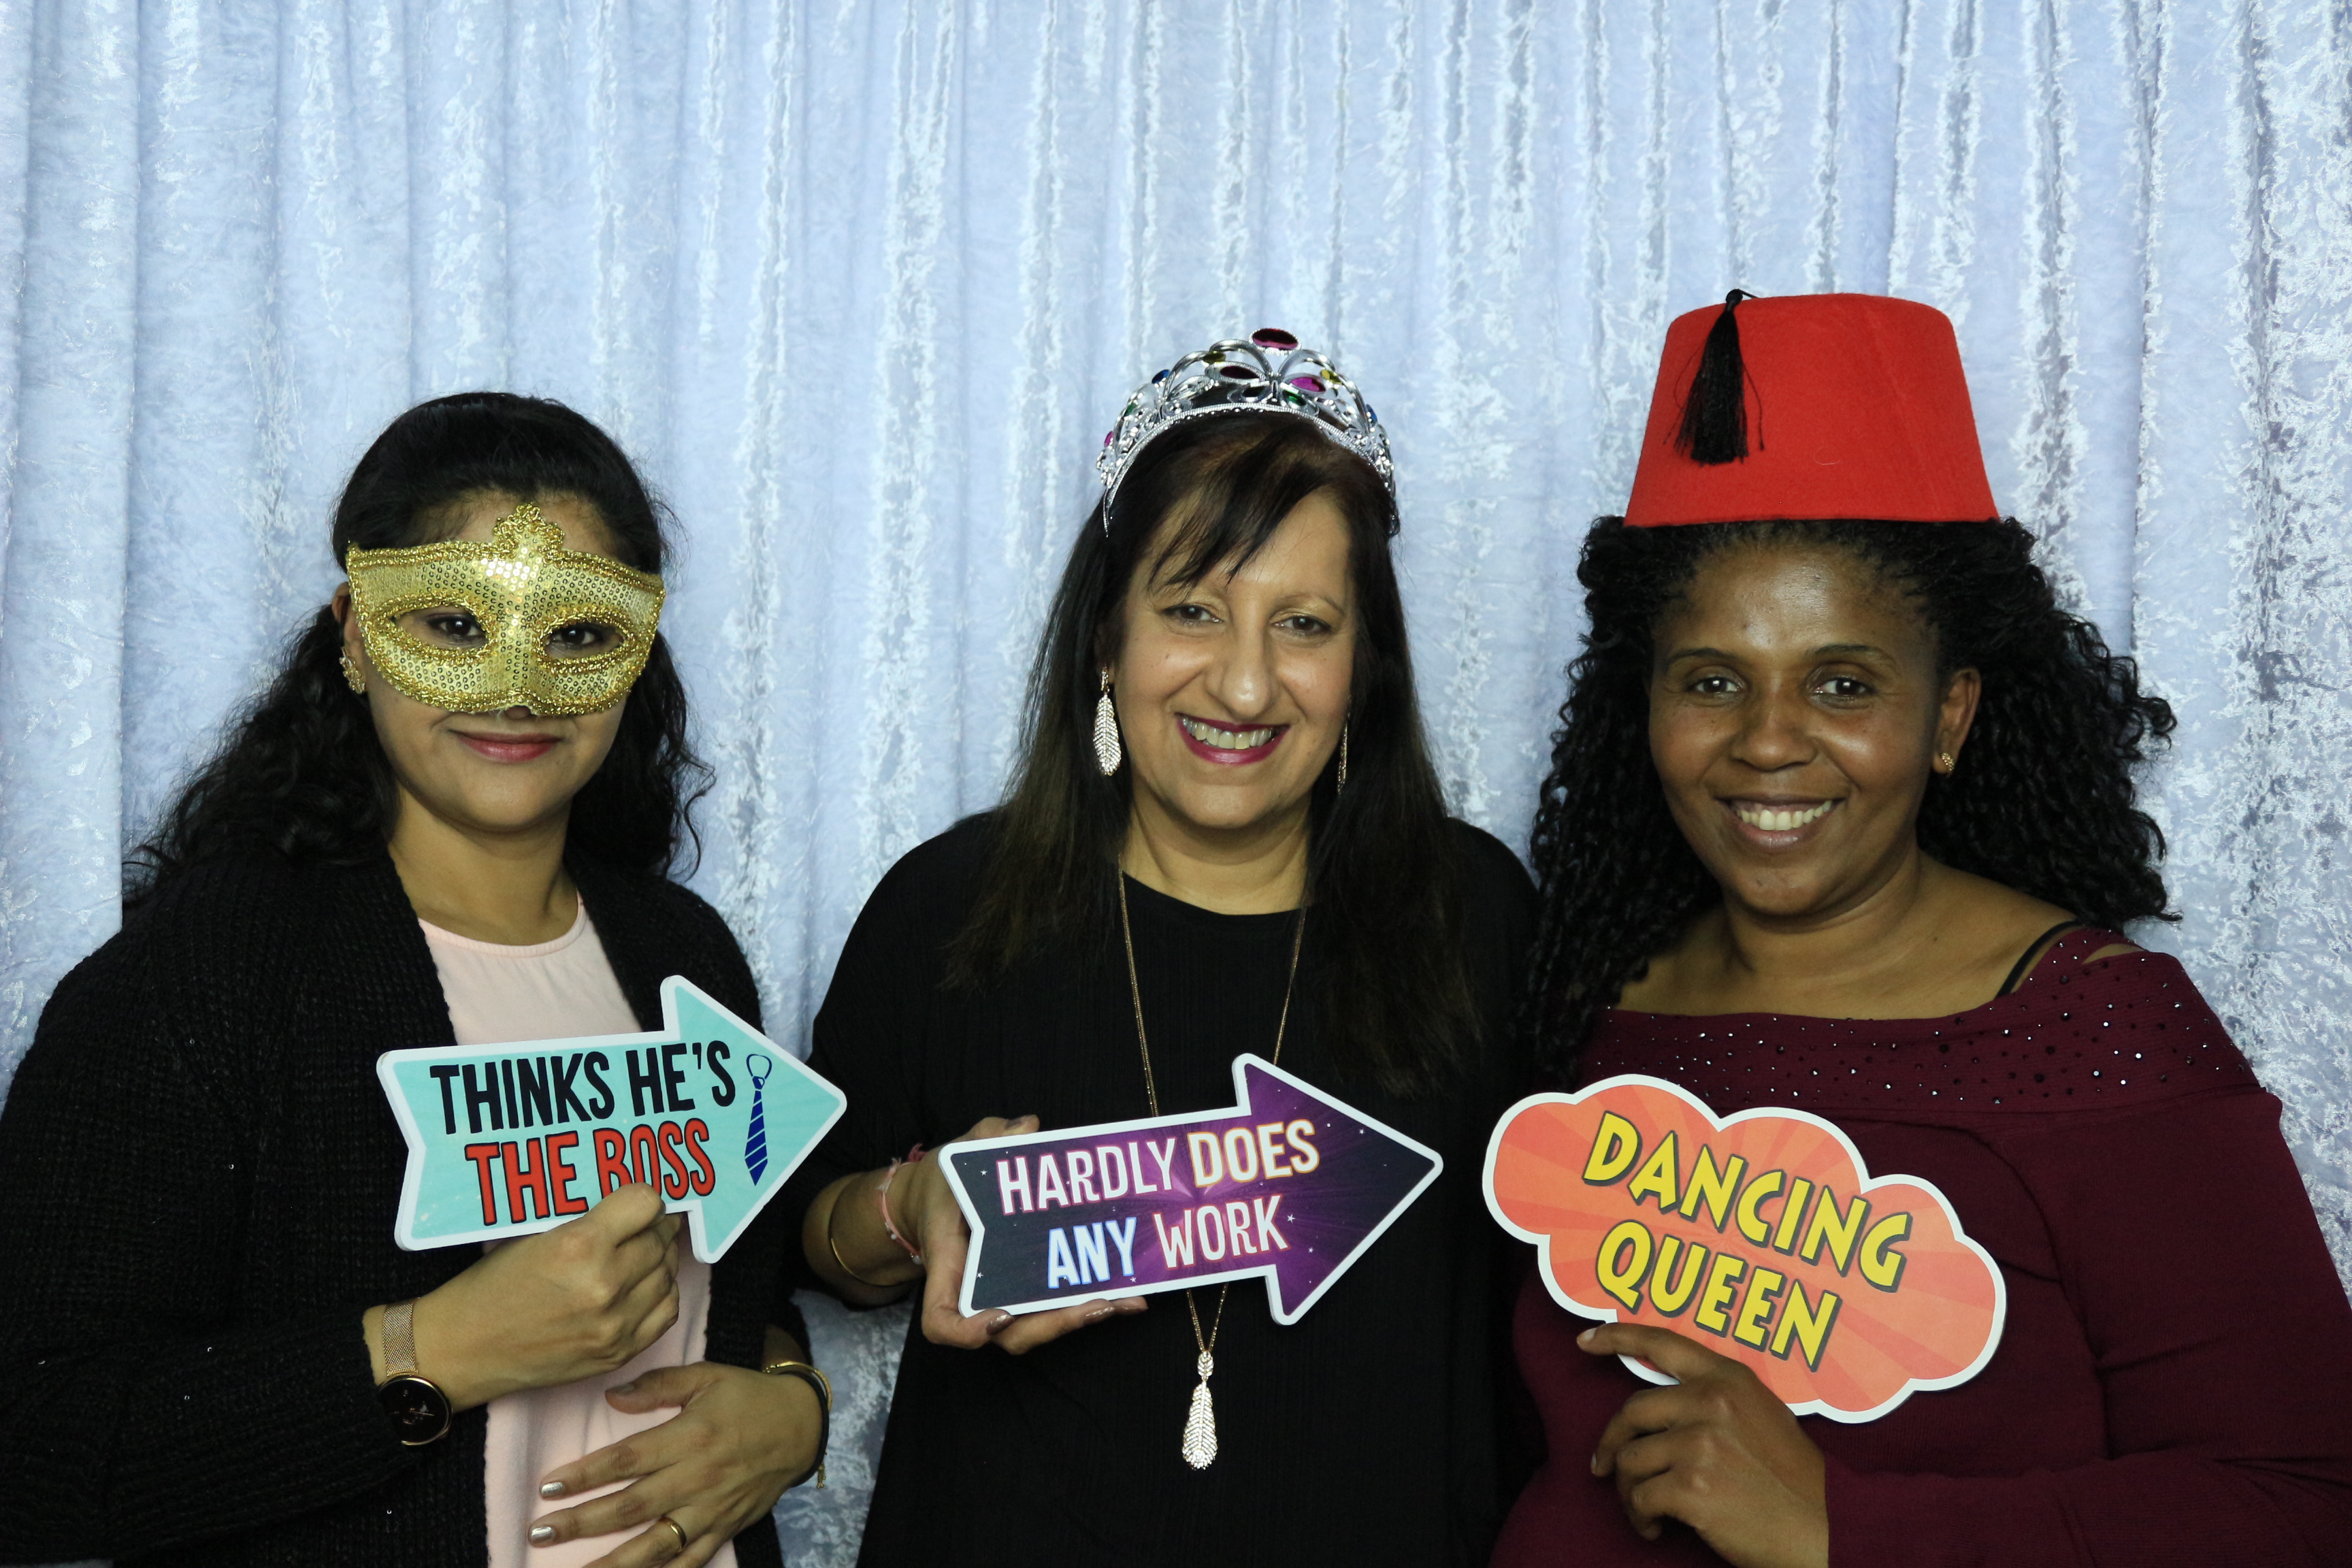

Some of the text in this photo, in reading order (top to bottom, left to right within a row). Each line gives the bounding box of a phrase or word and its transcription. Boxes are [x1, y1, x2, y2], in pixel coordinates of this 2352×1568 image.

[429, 1040, 736, 1135] THINKS HE'S
[465, 1118, 716, 1226] THE BOSS
[996, 1118, 1319, 1215] HARDLY DOES
[1582, 1111, 1912, 1293] DANCING
[1047, 1194, 1289, 1289] ANY WORK
[1595, 1220, 1842, 1372] QUEEN
